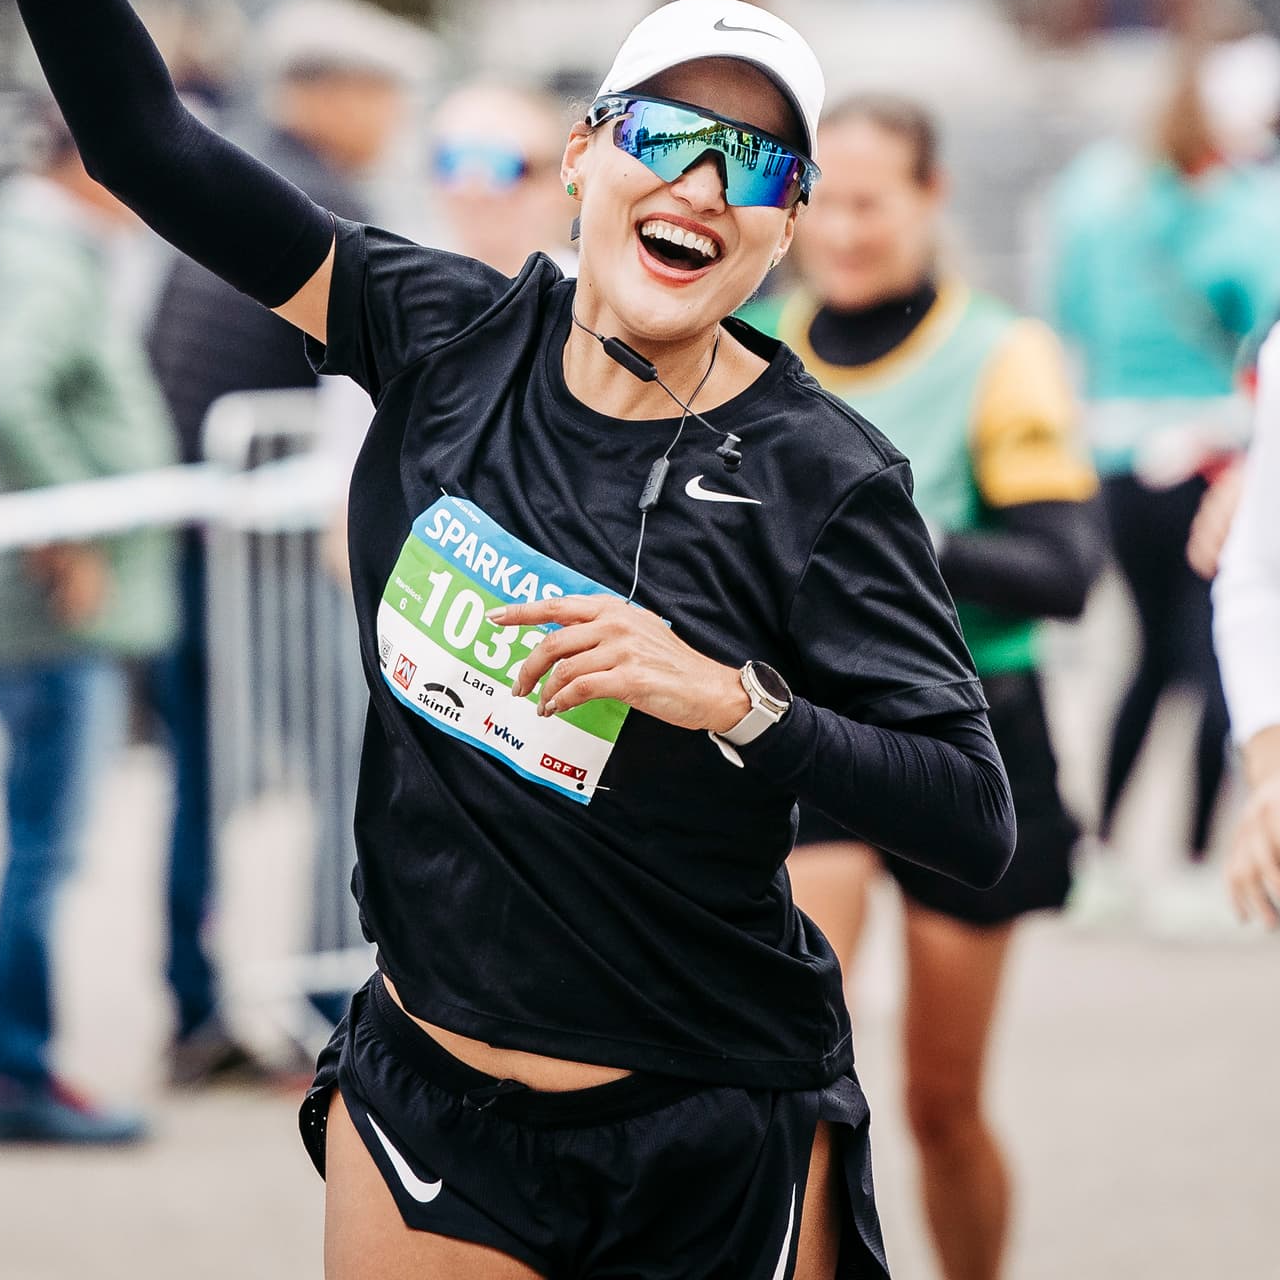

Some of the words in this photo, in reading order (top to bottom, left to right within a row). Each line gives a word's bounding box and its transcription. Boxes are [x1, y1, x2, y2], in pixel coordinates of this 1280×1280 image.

[399, 597, 408, 610] 6
[420, 570, 558, 702] 1032
[462, 671, 495, 697] Lara
[417, 692, 462, 722] skinfit
[493, 724, 525, 751] vkw
[542, 756, 572, 774] ORF
[574, 769, 585, 780] V
